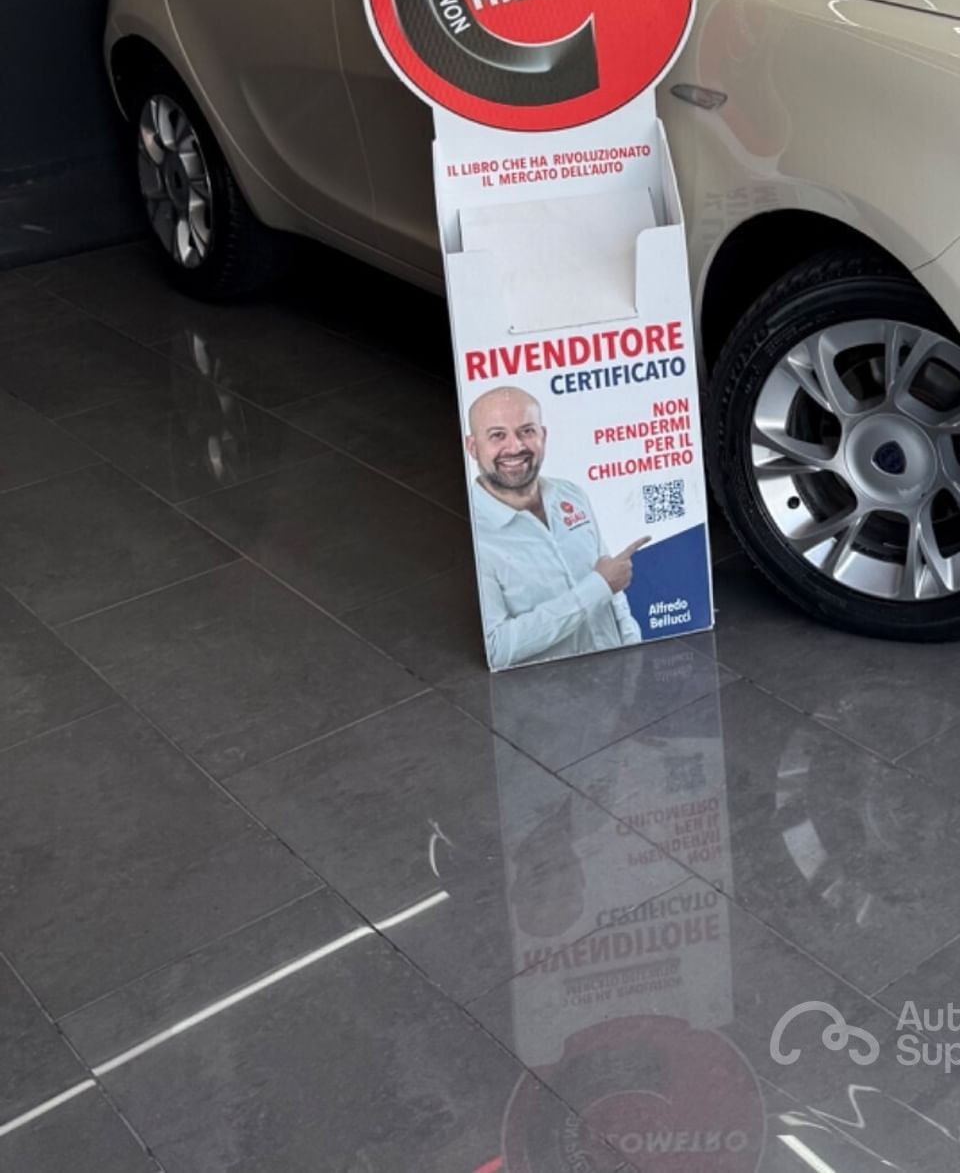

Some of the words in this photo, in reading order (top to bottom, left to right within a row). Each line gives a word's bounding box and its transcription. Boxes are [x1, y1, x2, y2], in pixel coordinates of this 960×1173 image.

[447, 164, 460, 177] IL
[461, 160, 499, 176] LIBRO
[502, 158, 527, 172] CHE
[529, 155, 548, 168] HA
[553, 144, 651, 166] RIVOLUZIONATO
[482, 176, 493, 187] IL
[499, 169, 558, 186] MERCATO
[561, 161, 624, 179] DELL'AUTO
[465, 321, 684, 382] RIVENDITORE
[551, 356, 686, 395] CERTIFICATO
[652, 398, 689, 418] NON
[594, 415, 691, 445] PRENDERMI
[644, 436, 674, 454] PER
[679, 433, 693, 447] IL
[588, 449, 694, 481] CHILOMETRO
[648, 598, 689, 617] Alfredo
[650, 612, 692, 629] Bellucci
